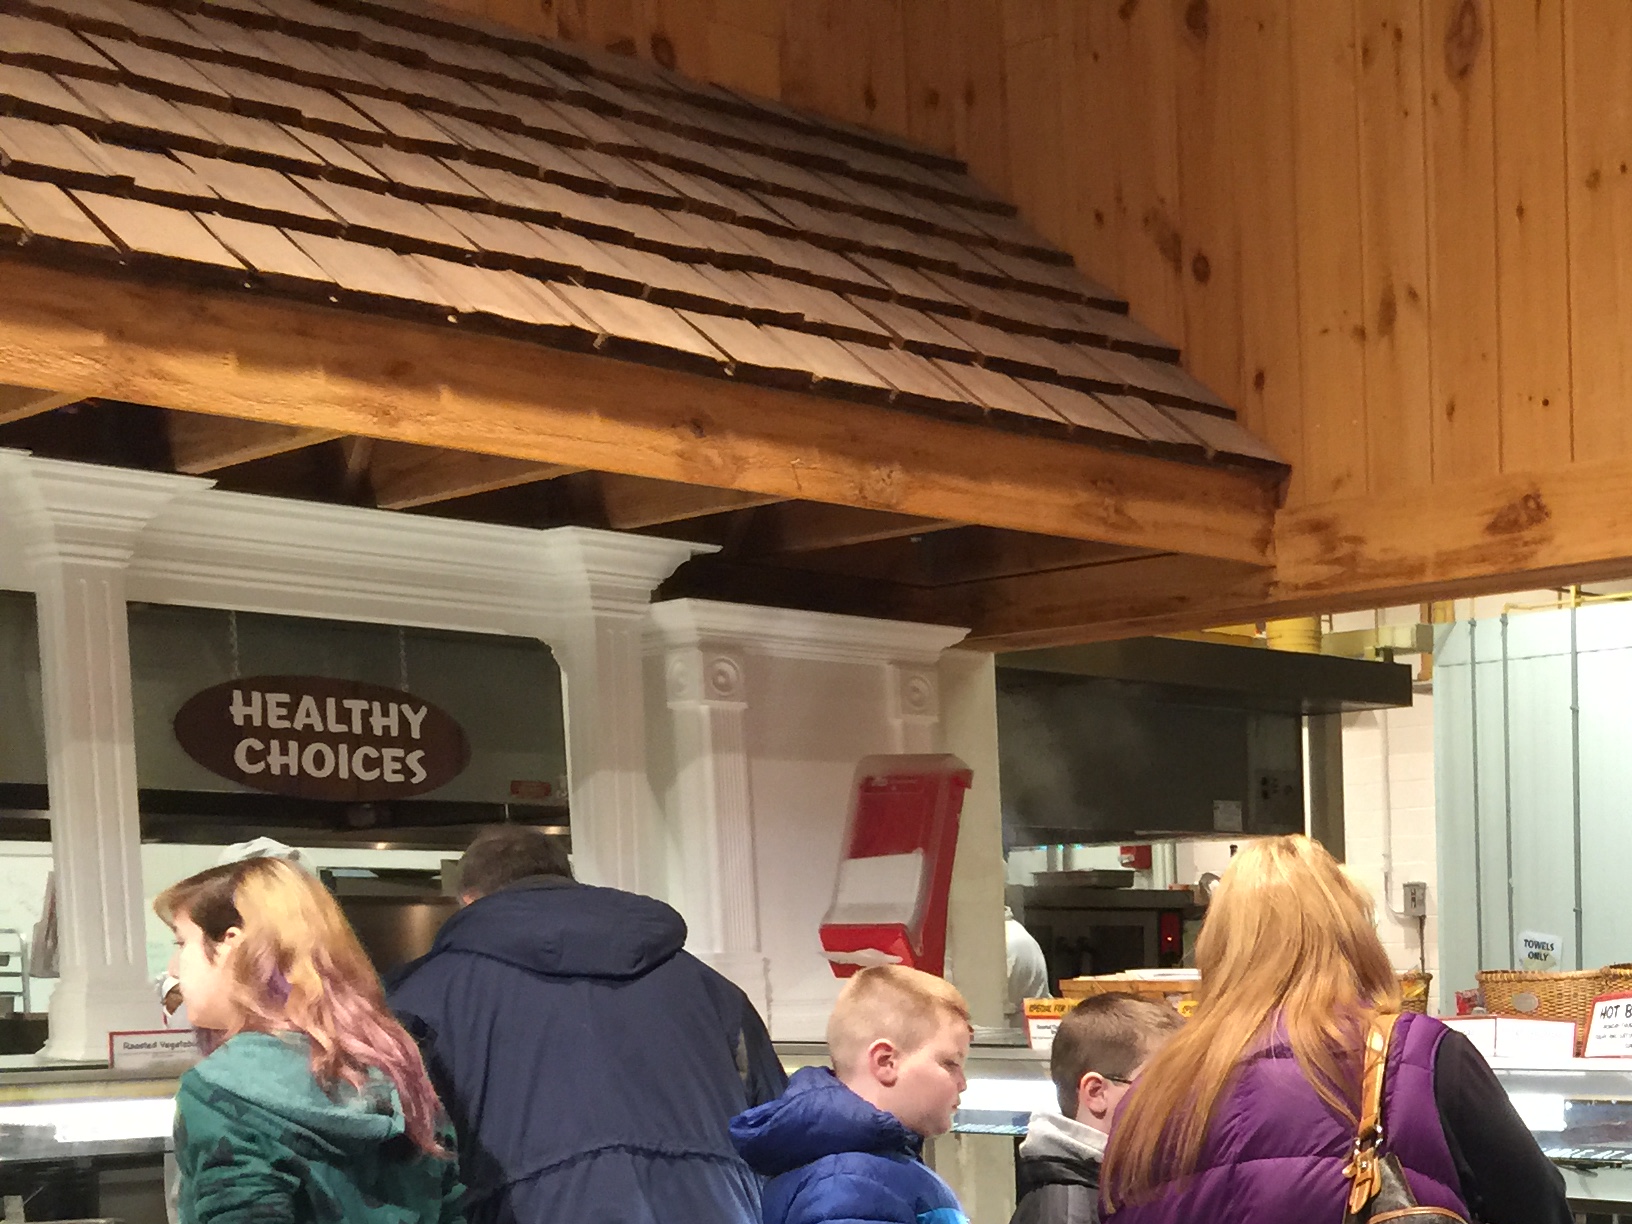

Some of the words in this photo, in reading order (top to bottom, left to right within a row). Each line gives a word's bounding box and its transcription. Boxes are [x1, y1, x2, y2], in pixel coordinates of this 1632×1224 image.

[229, 690, 428, 739] HEALTHY
[233, 738, 427, 784] CHOICES
[1523, 938, 1555, 951] TOWELS
[1527, 950, 1549, 961] ONLY
[1600, 1004, 1620, 1019] HOT
